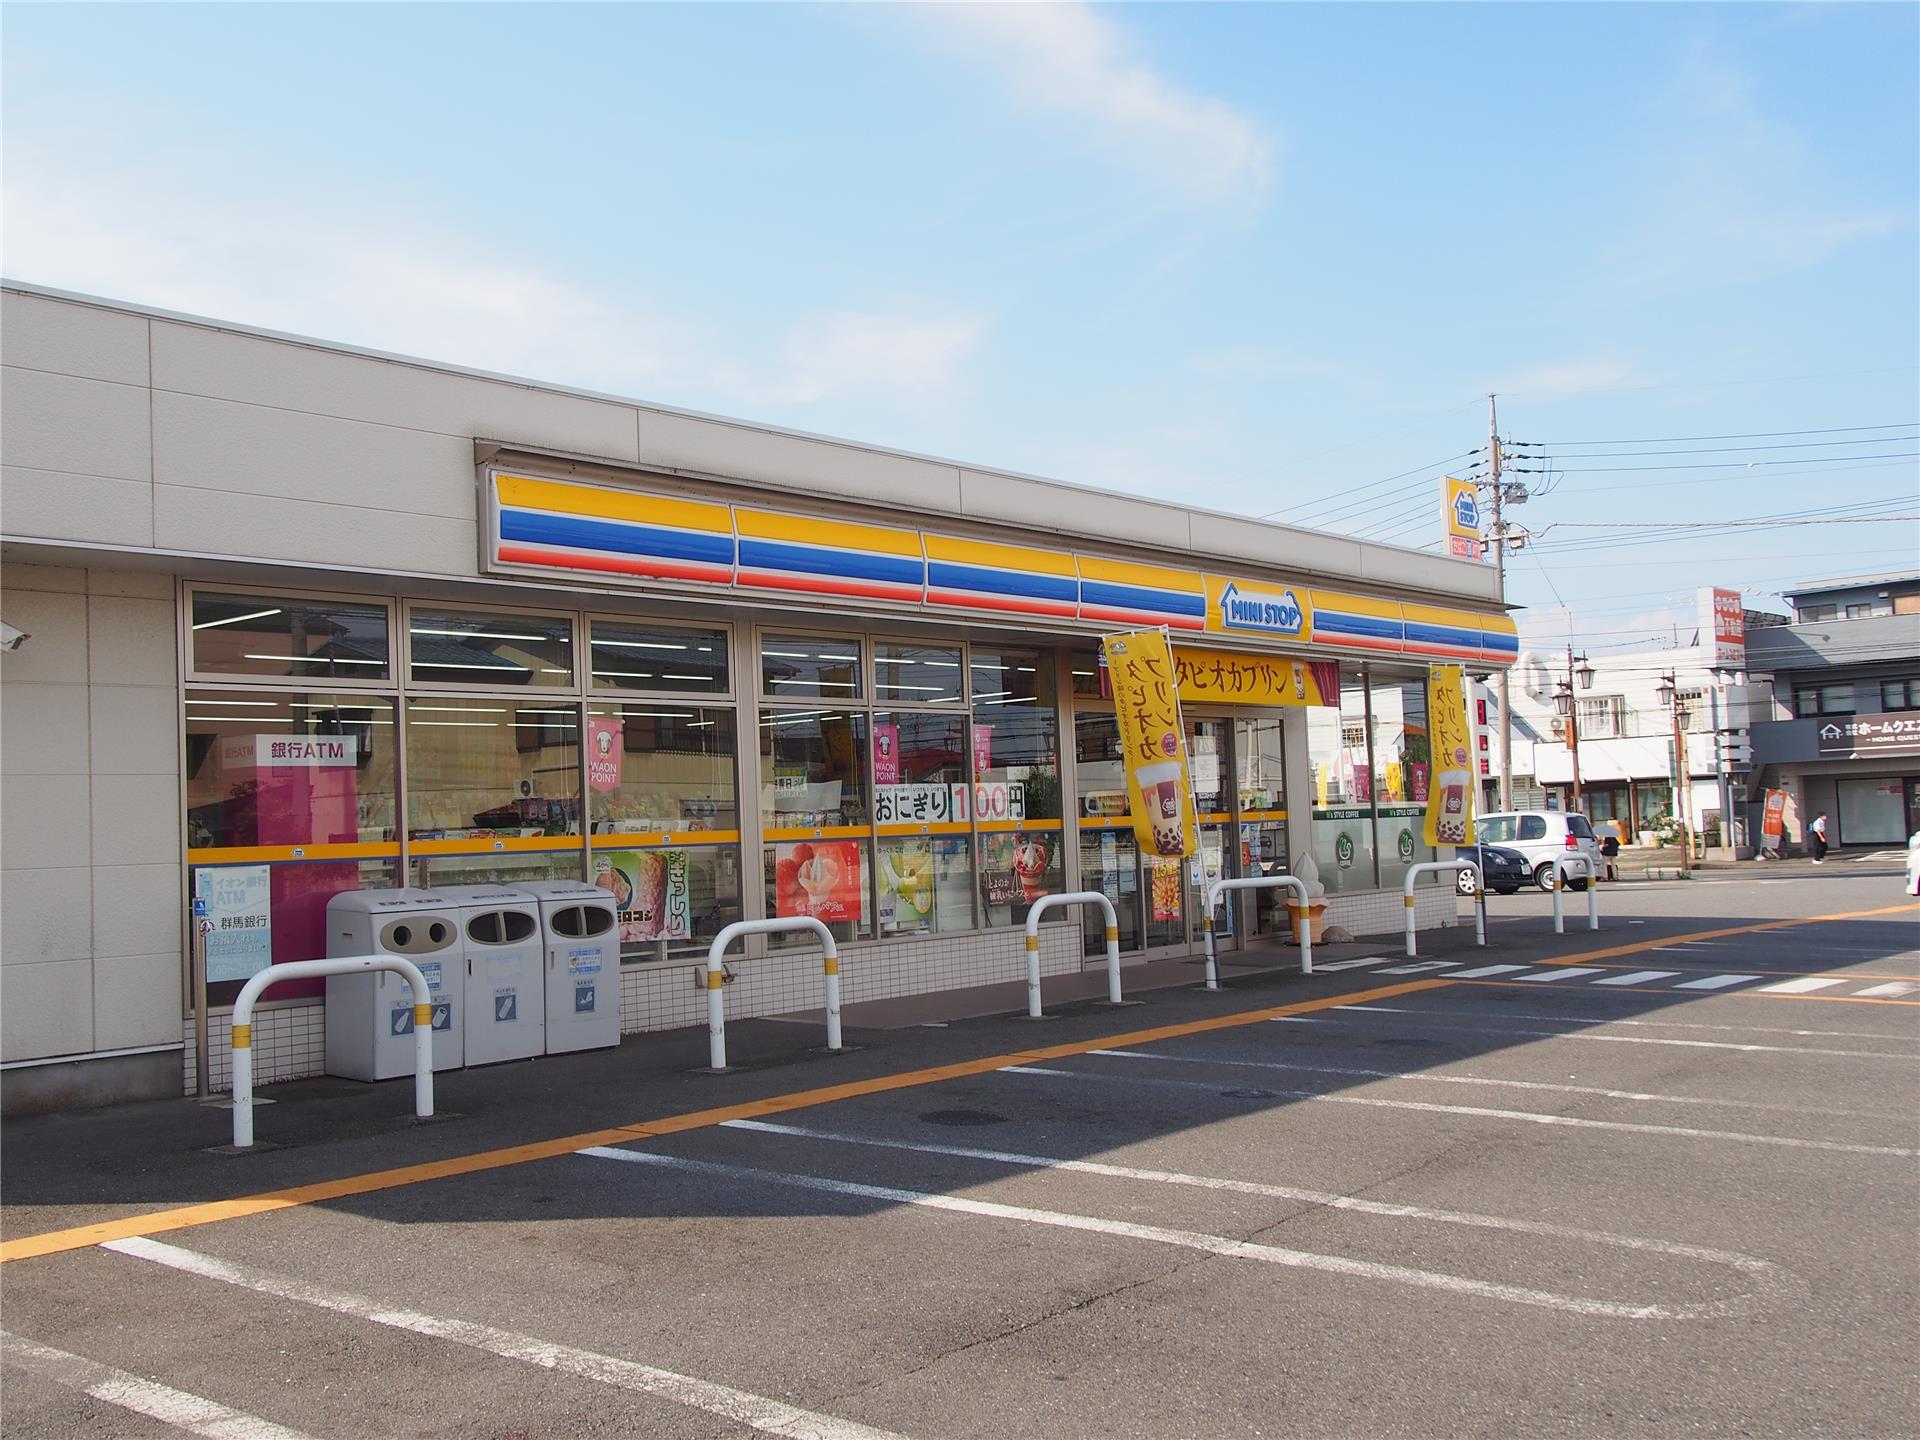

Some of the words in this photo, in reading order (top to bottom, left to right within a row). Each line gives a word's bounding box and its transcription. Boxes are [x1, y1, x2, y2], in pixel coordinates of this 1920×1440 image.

[1460, 512, 1475, 525] STOP
[1231, 599, 1263, 623] MINI
[1264, 603, 1298, 626] STOP
[1175, 656, 1288, 696] タピオカプリン
[271, 742, 344, 758] 銀行ATM
[590, 761, 617, 773] WAON
[875, 762, 896, 771] WAON
[590, 772, 617, 784] POINT
[876, 771, 896, 781] POINT
[875, 791, 947, 821] おにぎり
[954, 785, 1024, 819] 100円
[1334, 811, 1345, 819] STYLE
[1345, 810, 1360, 818] COFFEE
[1396, 809, 1407, 817] STYLE
[1407, 808, 1420, 816] COFFEE
[215, 875, 268, 890] イオン銀行
[216, 890, 246, 905] ATM
[221, 915, 268, 930] 群馬銀行
